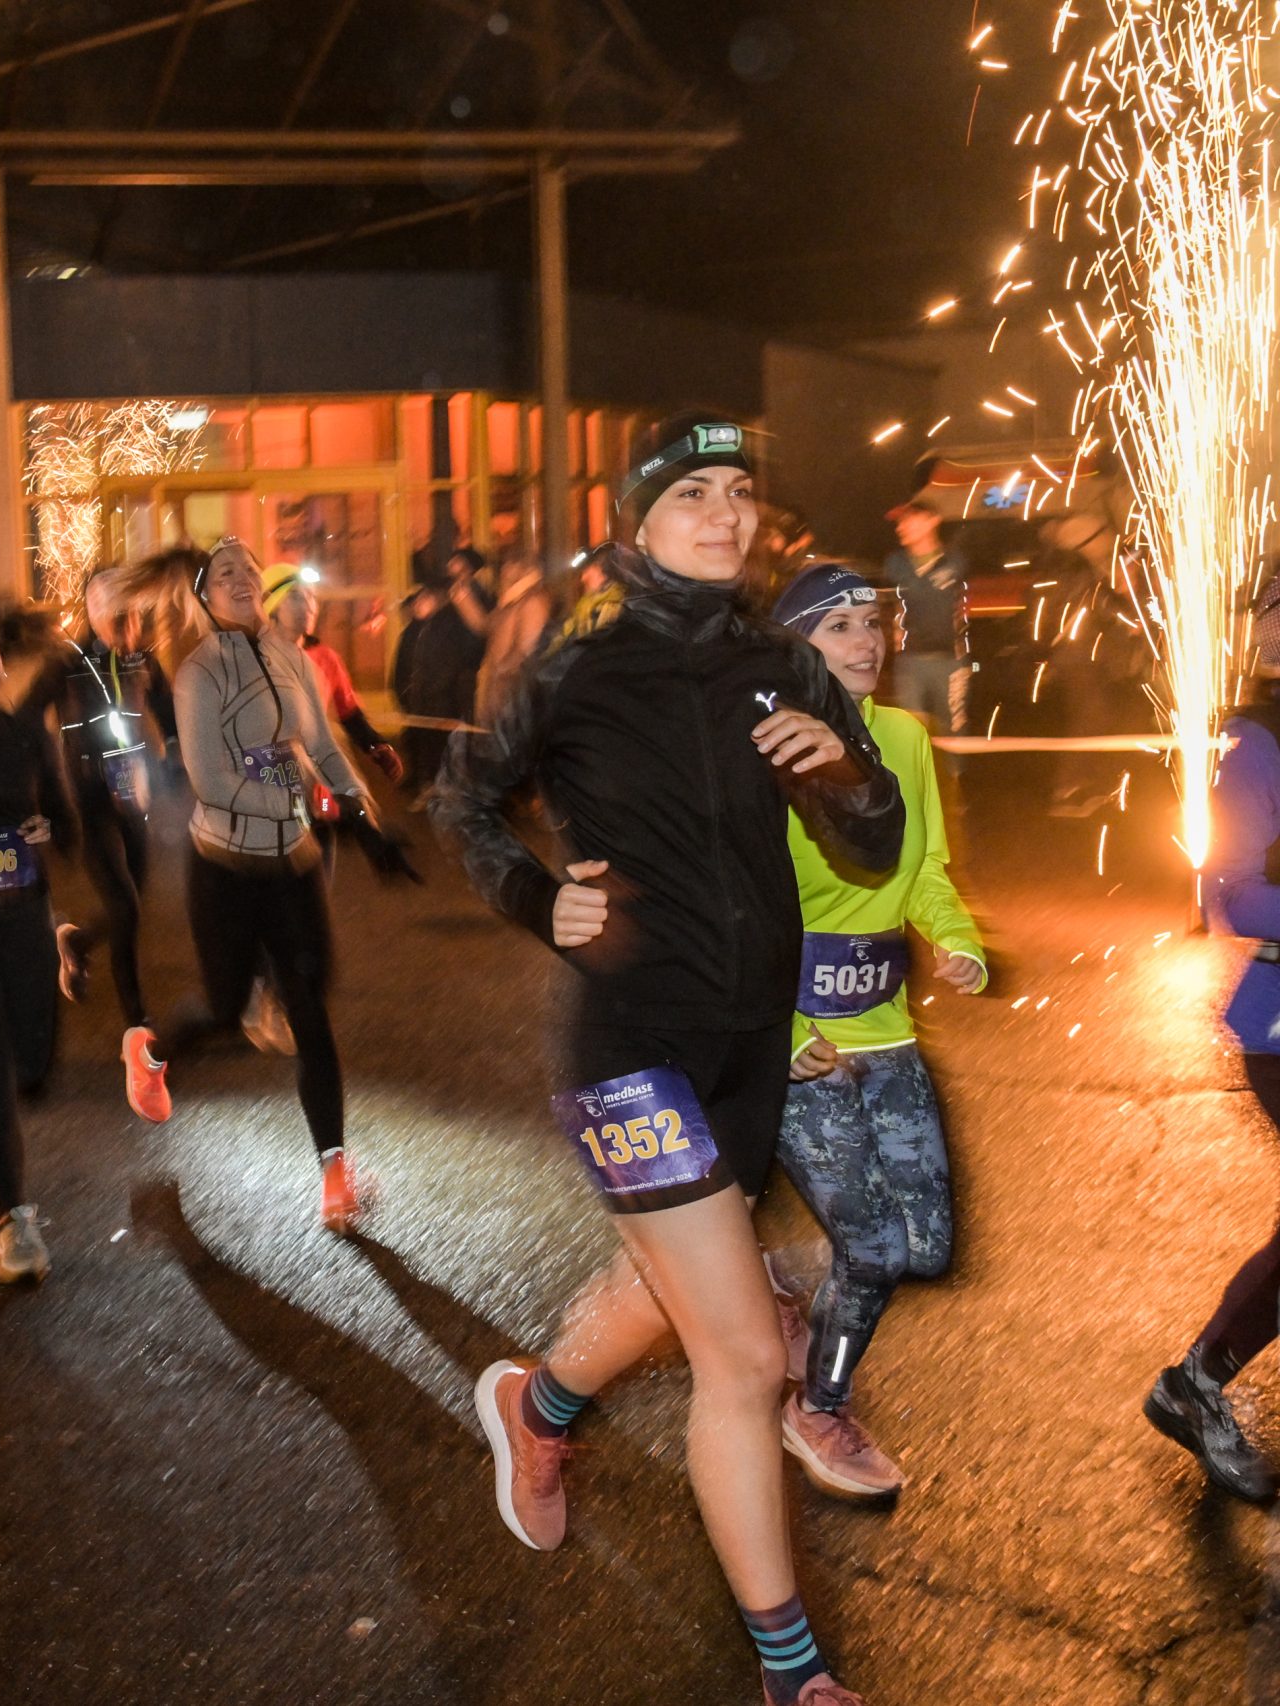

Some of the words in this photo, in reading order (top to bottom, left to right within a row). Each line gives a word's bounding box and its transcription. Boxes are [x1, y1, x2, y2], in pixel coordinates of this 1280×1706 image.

[641, 457, 664, 476] PETZL
[260, 760, 301, 786] 212
[813, 961, 890, 996] 5031
[580, 1108, 691, 1167] 1352
[655, 1177, 676, 1187] Zürich
[676, 1172, 692, 1182] 2024
